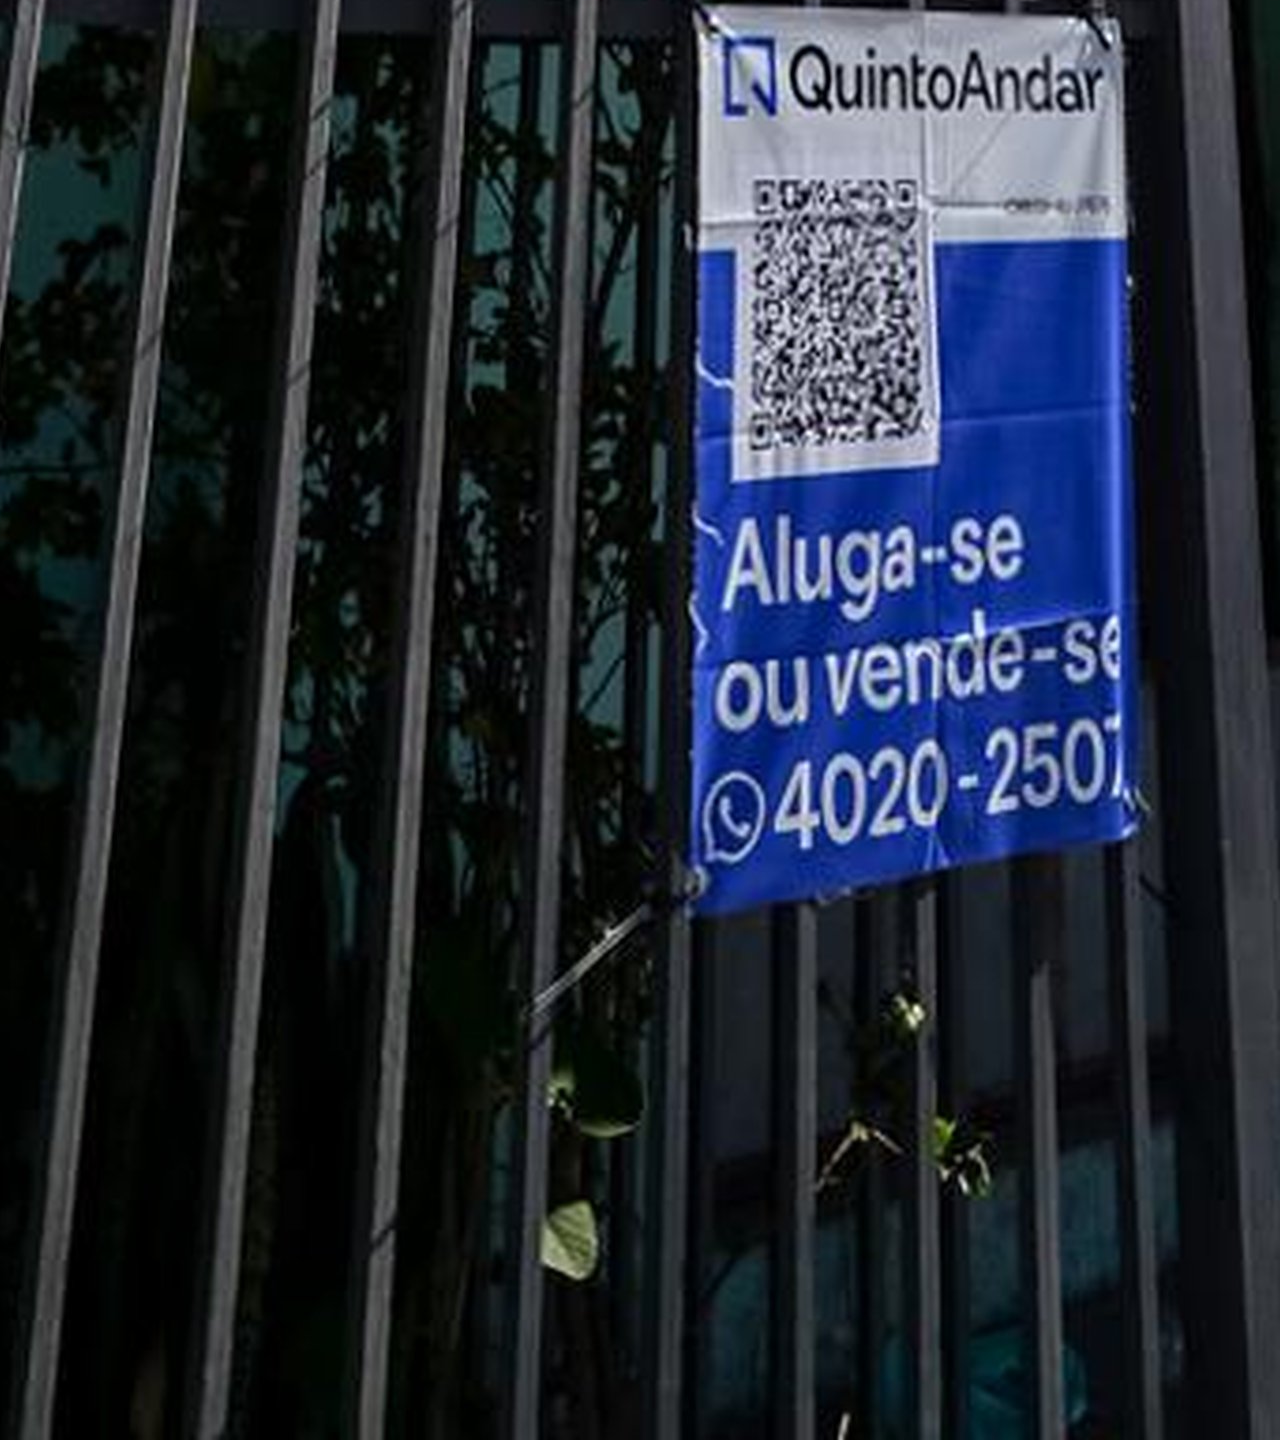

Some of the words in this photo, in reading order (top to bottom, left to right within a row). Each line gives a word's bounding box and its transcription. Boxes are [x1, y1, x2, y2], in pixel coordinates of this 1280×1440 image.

[788, 44, 1106, 115] QuintoAndar
[721, 513, 1025, 622] Aluga-se
[714, 656, 812, 733] ou
